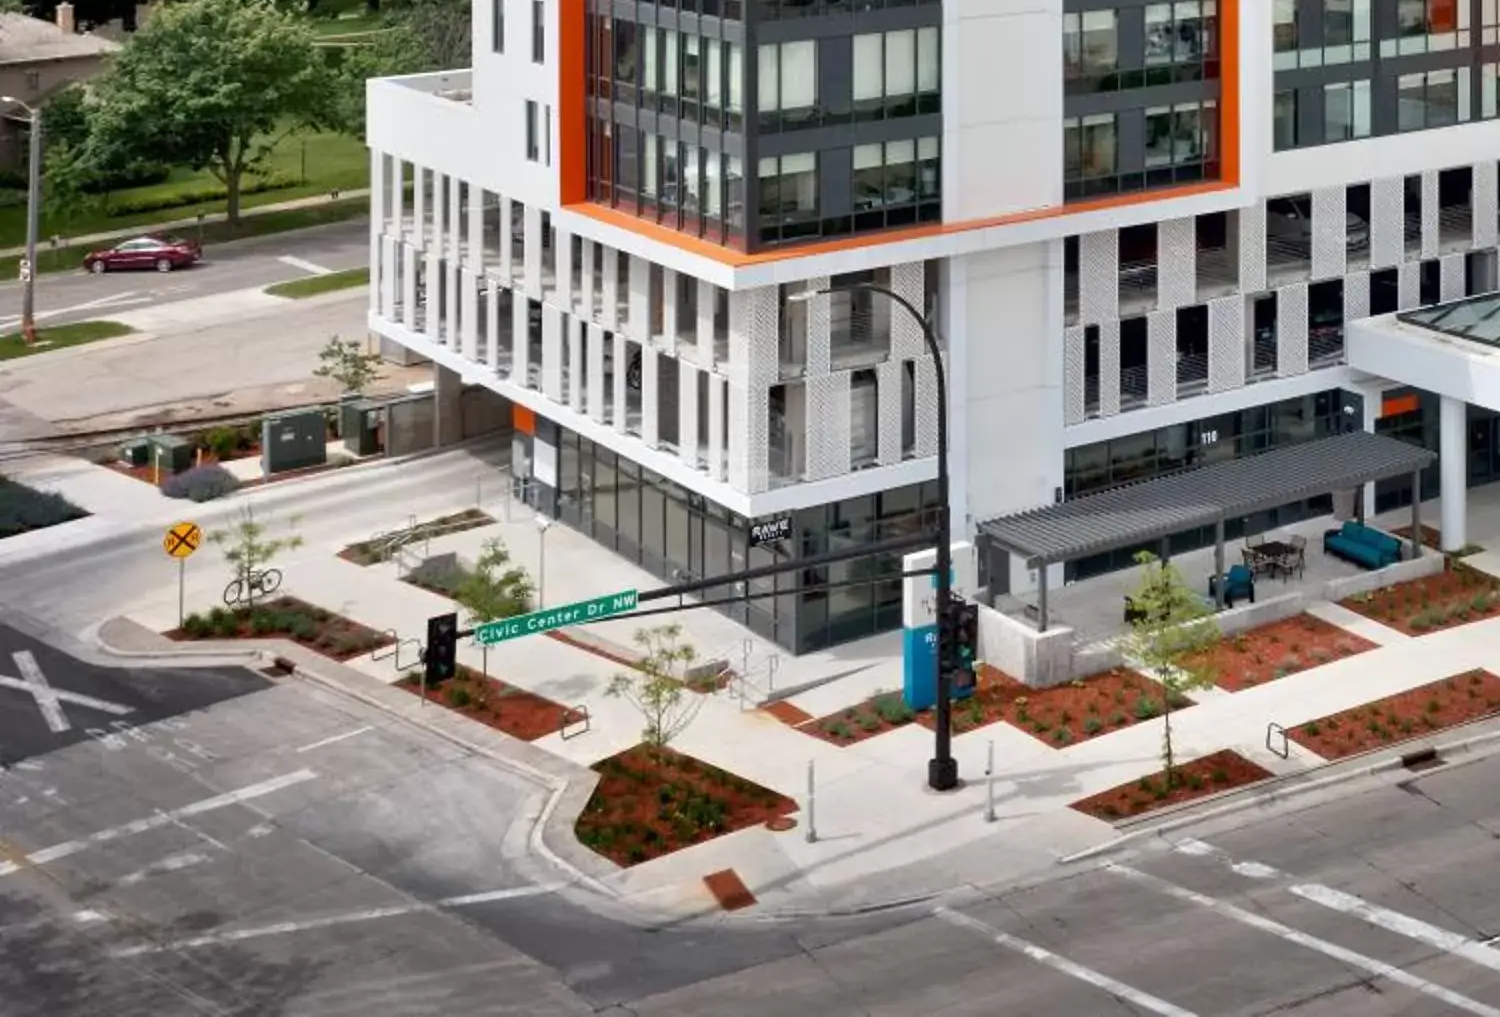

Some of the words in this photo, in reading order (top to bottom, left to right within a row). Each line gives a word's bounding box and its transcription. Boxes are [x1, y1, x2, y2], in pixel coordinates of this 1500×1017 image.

[479, 624, 520, 643] Civic
[527, 610, 580, 631] Center
[587, 604, 605, 616] Dr
[613, 595, 636, 608] NW
